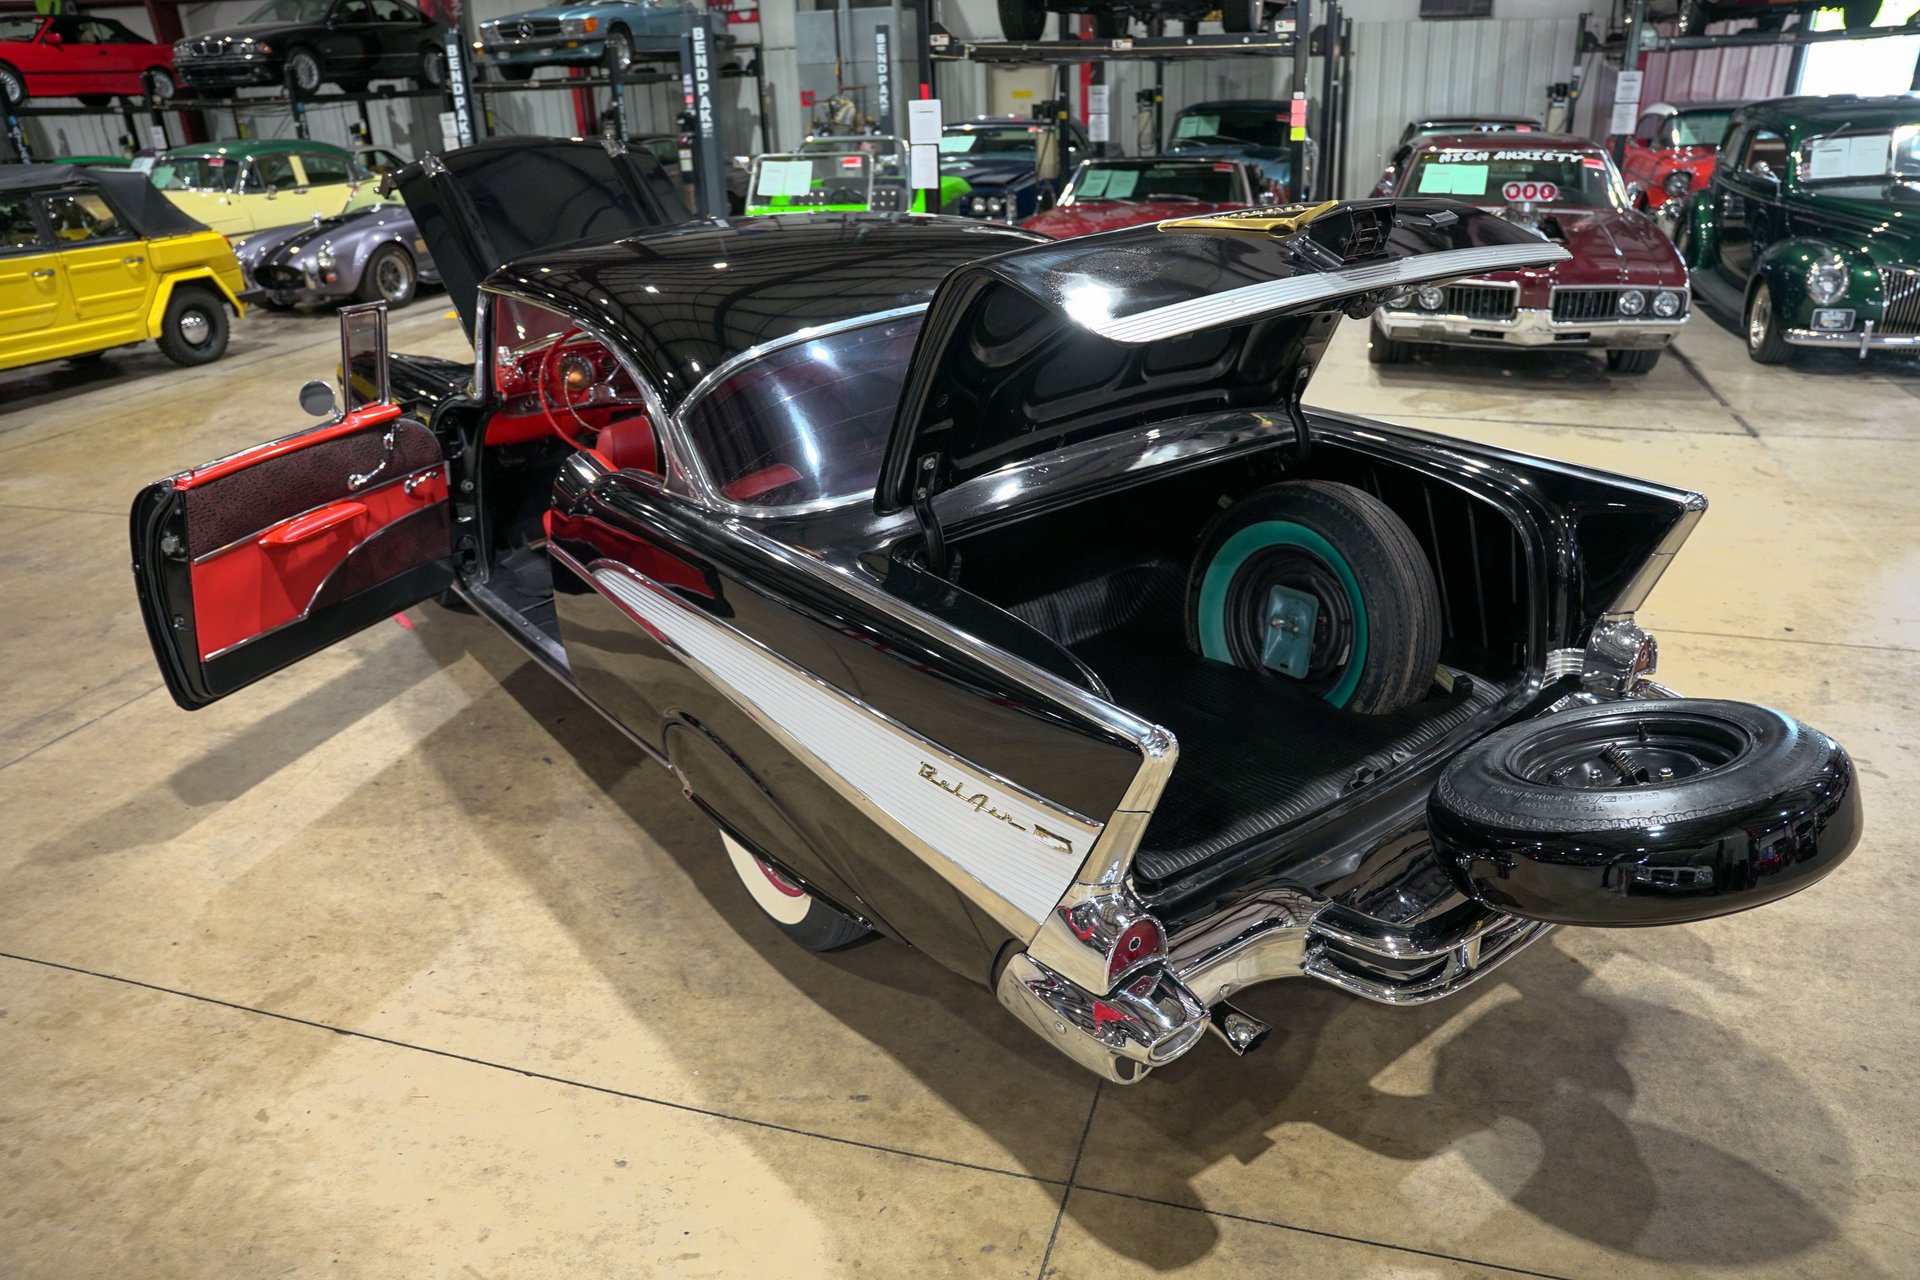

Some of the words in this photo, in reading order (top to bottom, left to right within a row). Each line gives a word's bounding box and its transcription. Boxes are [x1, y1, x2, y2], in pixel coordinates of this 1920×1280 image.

[446, 44, 470, 134] BENDPAK
[692, 27, 712, 122] BENDPAK
[876, 33, 889, 105] BENDPAK
[1439, 152, 1489, 163] HIGH
[1493, 151, 1584, 163] ANXIETY
